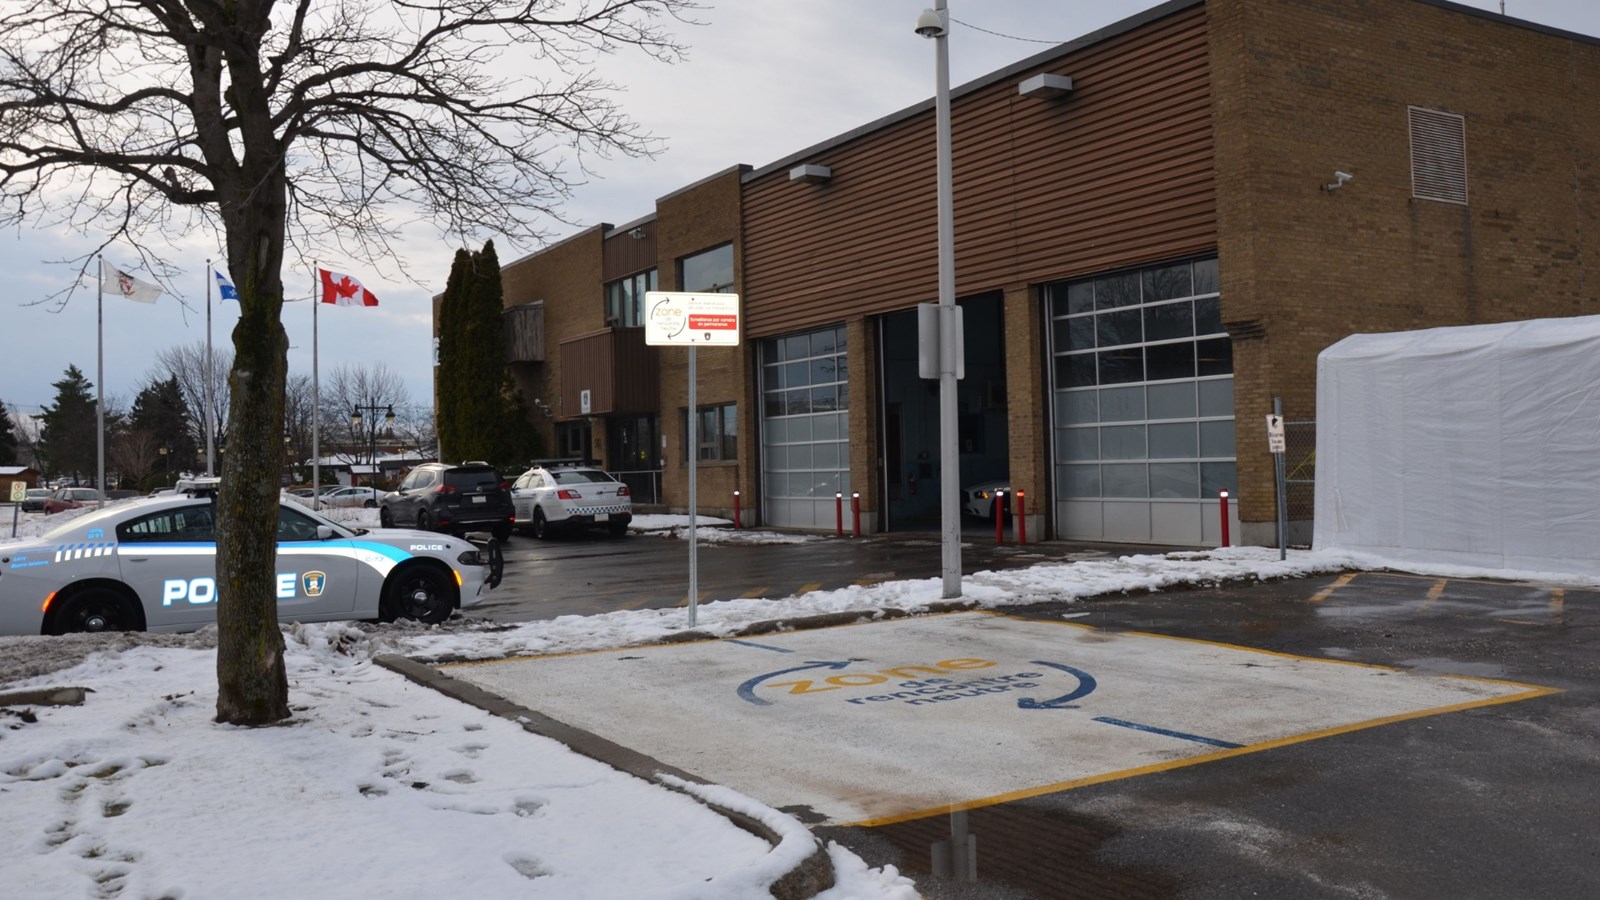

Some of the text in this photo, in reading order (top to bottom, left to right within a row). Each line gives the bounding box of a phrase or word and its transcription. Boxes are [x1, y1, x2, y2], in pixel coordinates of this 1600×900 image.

[655, 308, 682, 317] zone
[162, 573, 297, 606] POE
[767, 658, 998, 695] zone
[845, 671, 1043, 705] rencontre
[899, 678, 953, 689] de
[904, 682, 1039, 705] neutre
